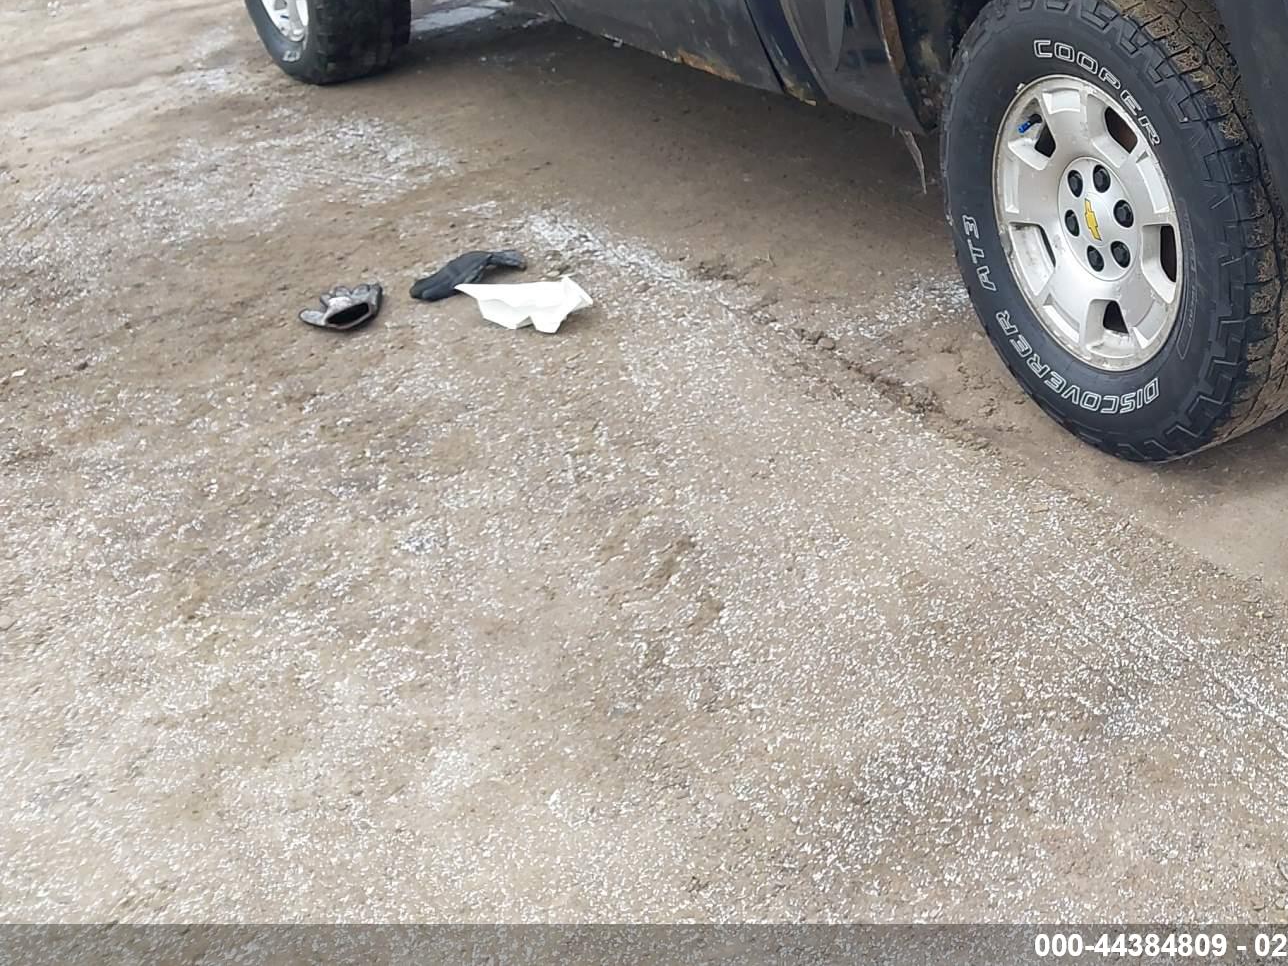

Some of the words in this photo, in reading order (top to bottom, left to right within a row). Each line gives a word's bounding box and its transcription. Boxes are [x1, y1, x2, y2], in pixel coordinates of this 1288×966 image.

[1033, 38, 1161, 146] COOPER
[962, 214, 997, 292] AT3
[995, 309, 1160, 414] DISCOVERER
